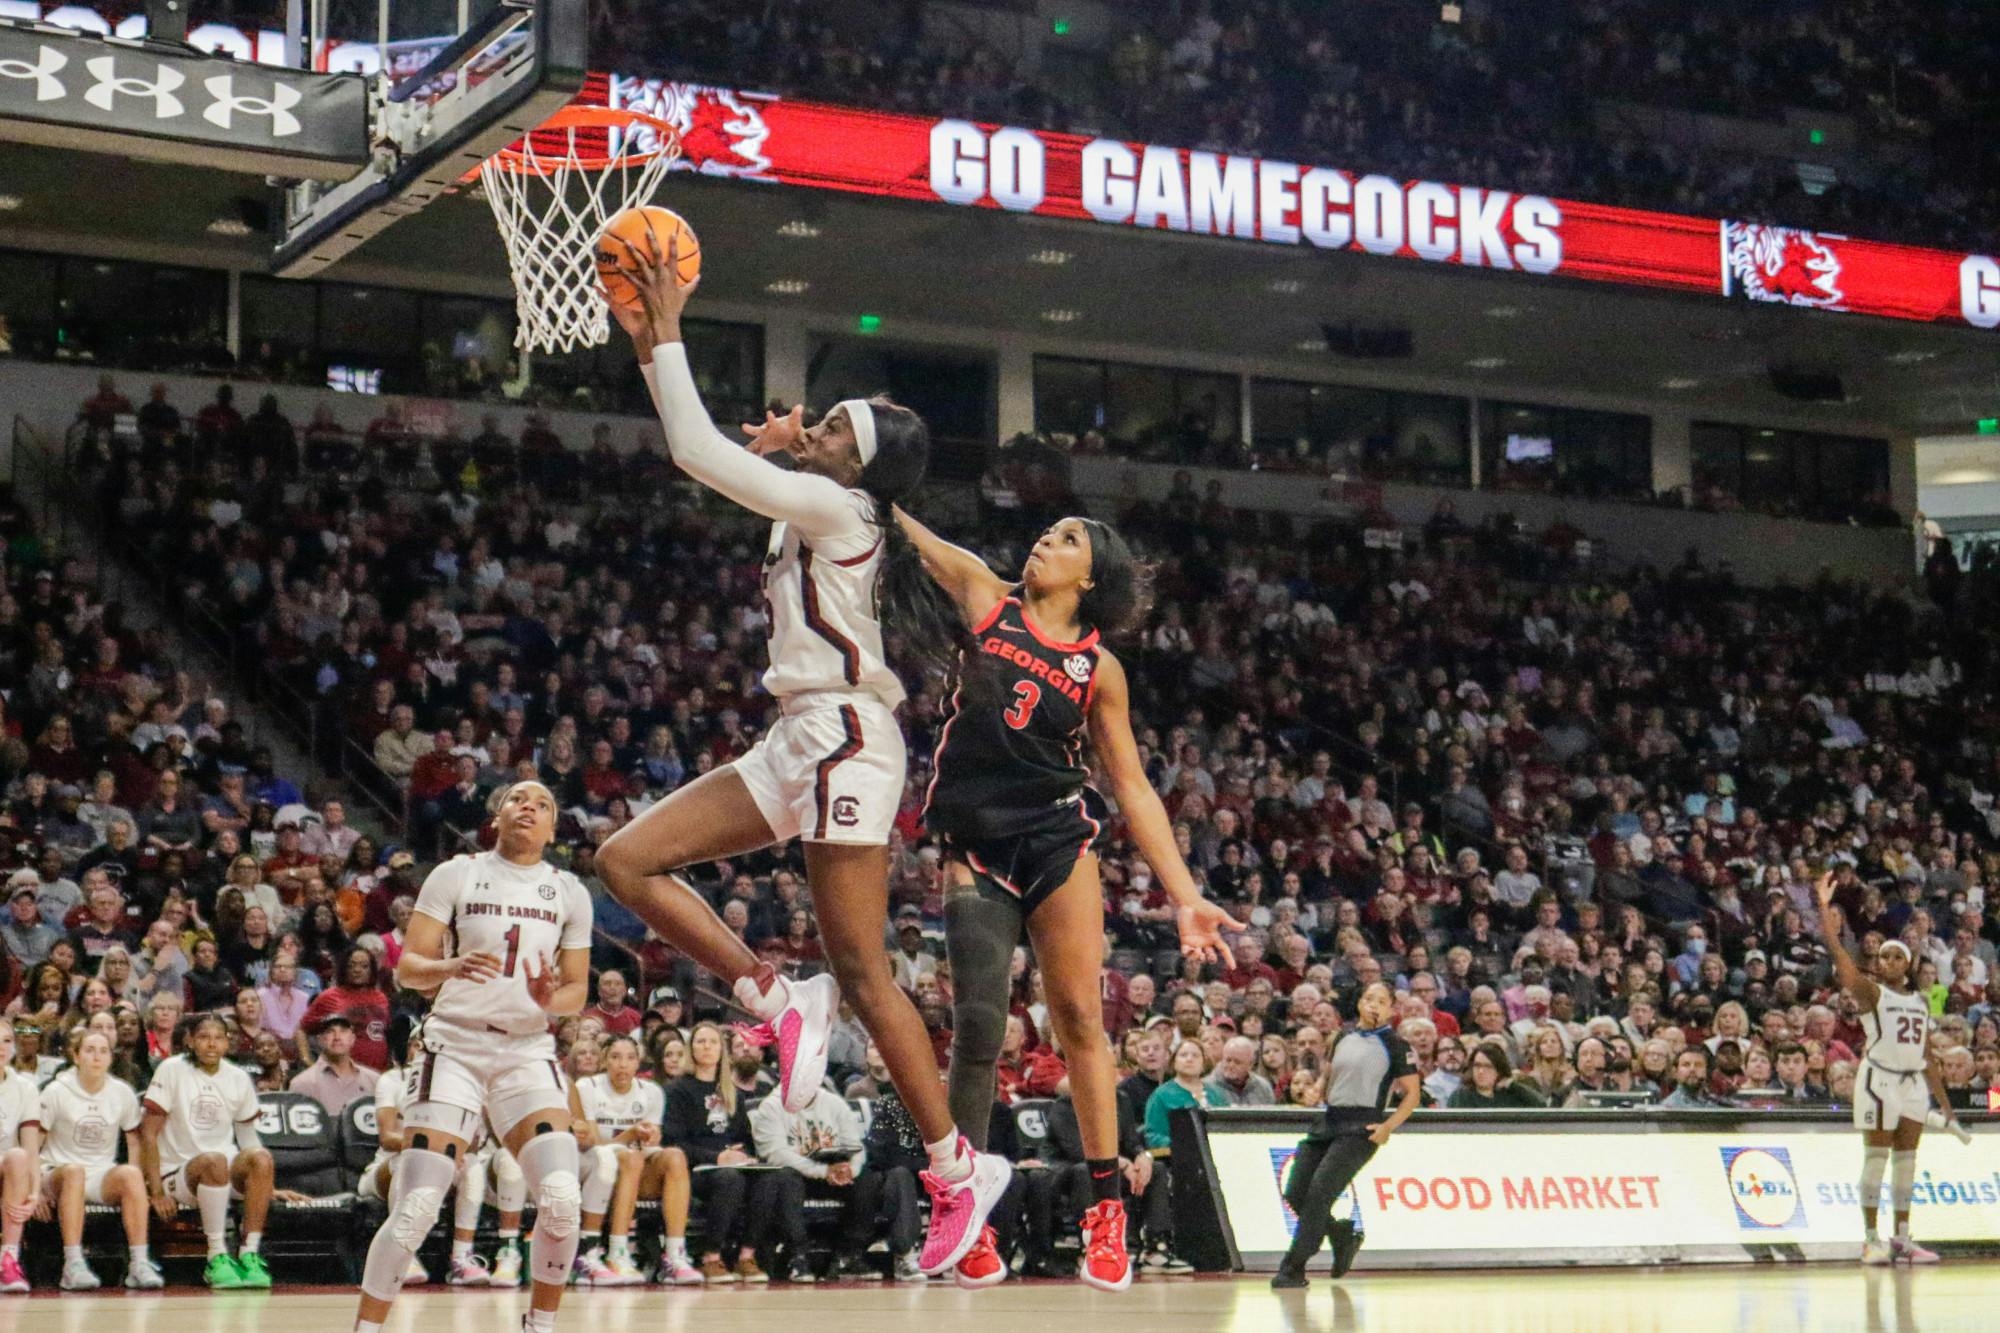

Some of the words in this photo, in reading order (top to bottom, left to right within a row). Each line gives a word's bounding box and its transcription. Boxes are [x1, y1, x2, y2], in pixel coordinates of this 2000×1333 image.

[929, 118, 1046, 213] GO
[1081, 138, 1563, 275] GAMECOCKS
[984, 637, 1083, 705] GEORGIA
[1003, 679, 1041, 730] 3
[465, 902, 502, 916] SOUTH
[507, 905, 559, 925] CAROLINA
[503, 923, 521, 978] 1
[1896, 1016, 1924, 1045] 25
[1373, 1176, 1493, 1211] FOOD
[1501, 1176, 1661, 1210] MARKET
